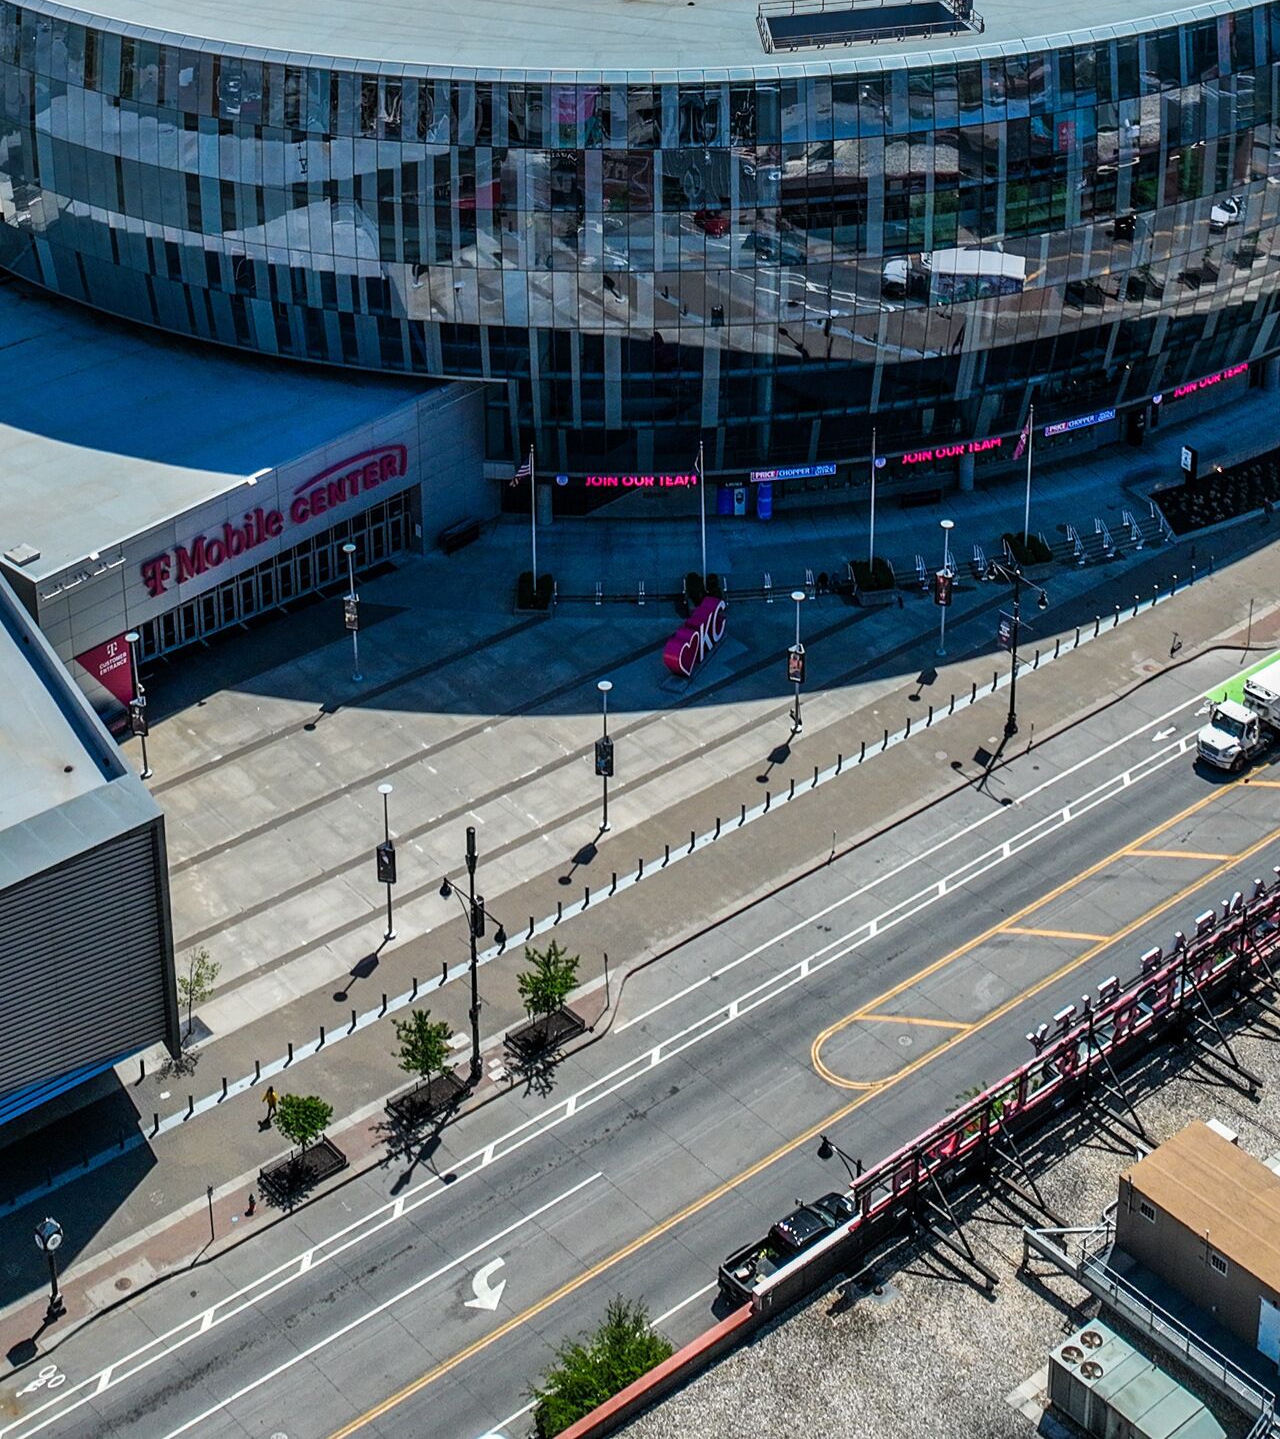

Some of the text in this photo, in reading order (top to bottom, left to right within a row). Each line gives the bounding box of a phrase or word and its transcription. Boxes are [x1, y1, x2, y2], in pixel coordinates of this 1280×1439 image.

[1173, 363, 1249, 398] JOIN OUR TEAM
[902, 437, 1003, 465] JOIN OUR TEAM
[585, 475, 697, 487] JOIN OUR TEAM
[175, 507, 285, 585] Mobile
[290, 450, 402, 525] CENTER
[700, 600, 727, 662] KC
[99, 651, 128, 670] CUSTOMER
[99, 657, 128, 676] ENTRANCE
